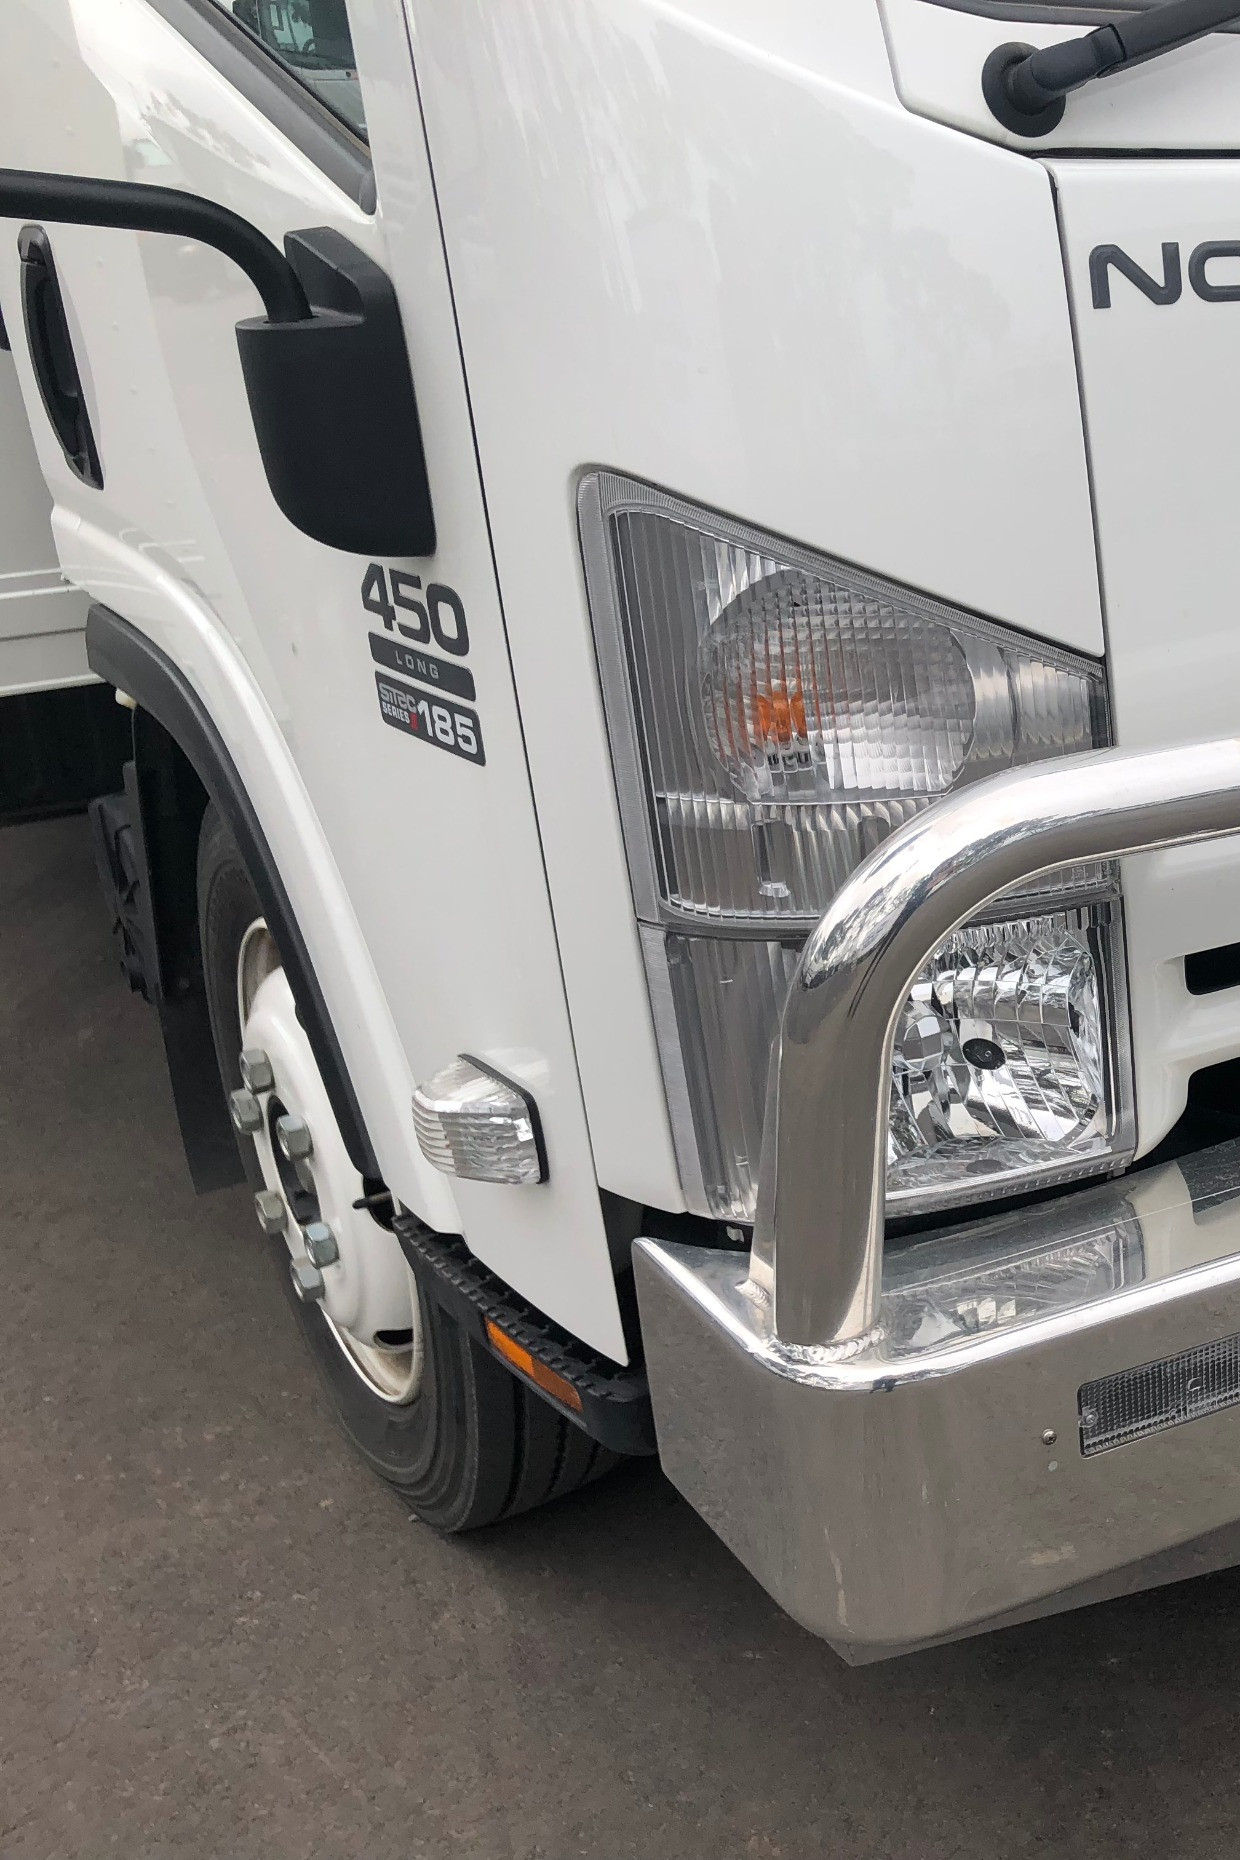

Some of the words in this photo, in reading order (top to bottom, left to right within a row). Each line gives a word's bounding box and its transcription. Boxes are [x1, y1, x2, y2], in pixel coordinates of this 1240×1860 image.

[361, 562, 470, 657] 450
[396, 650, 439, 679] LONG
[382, 700, 410, 724] SERIES
[417, 699, 478, 755] 185
